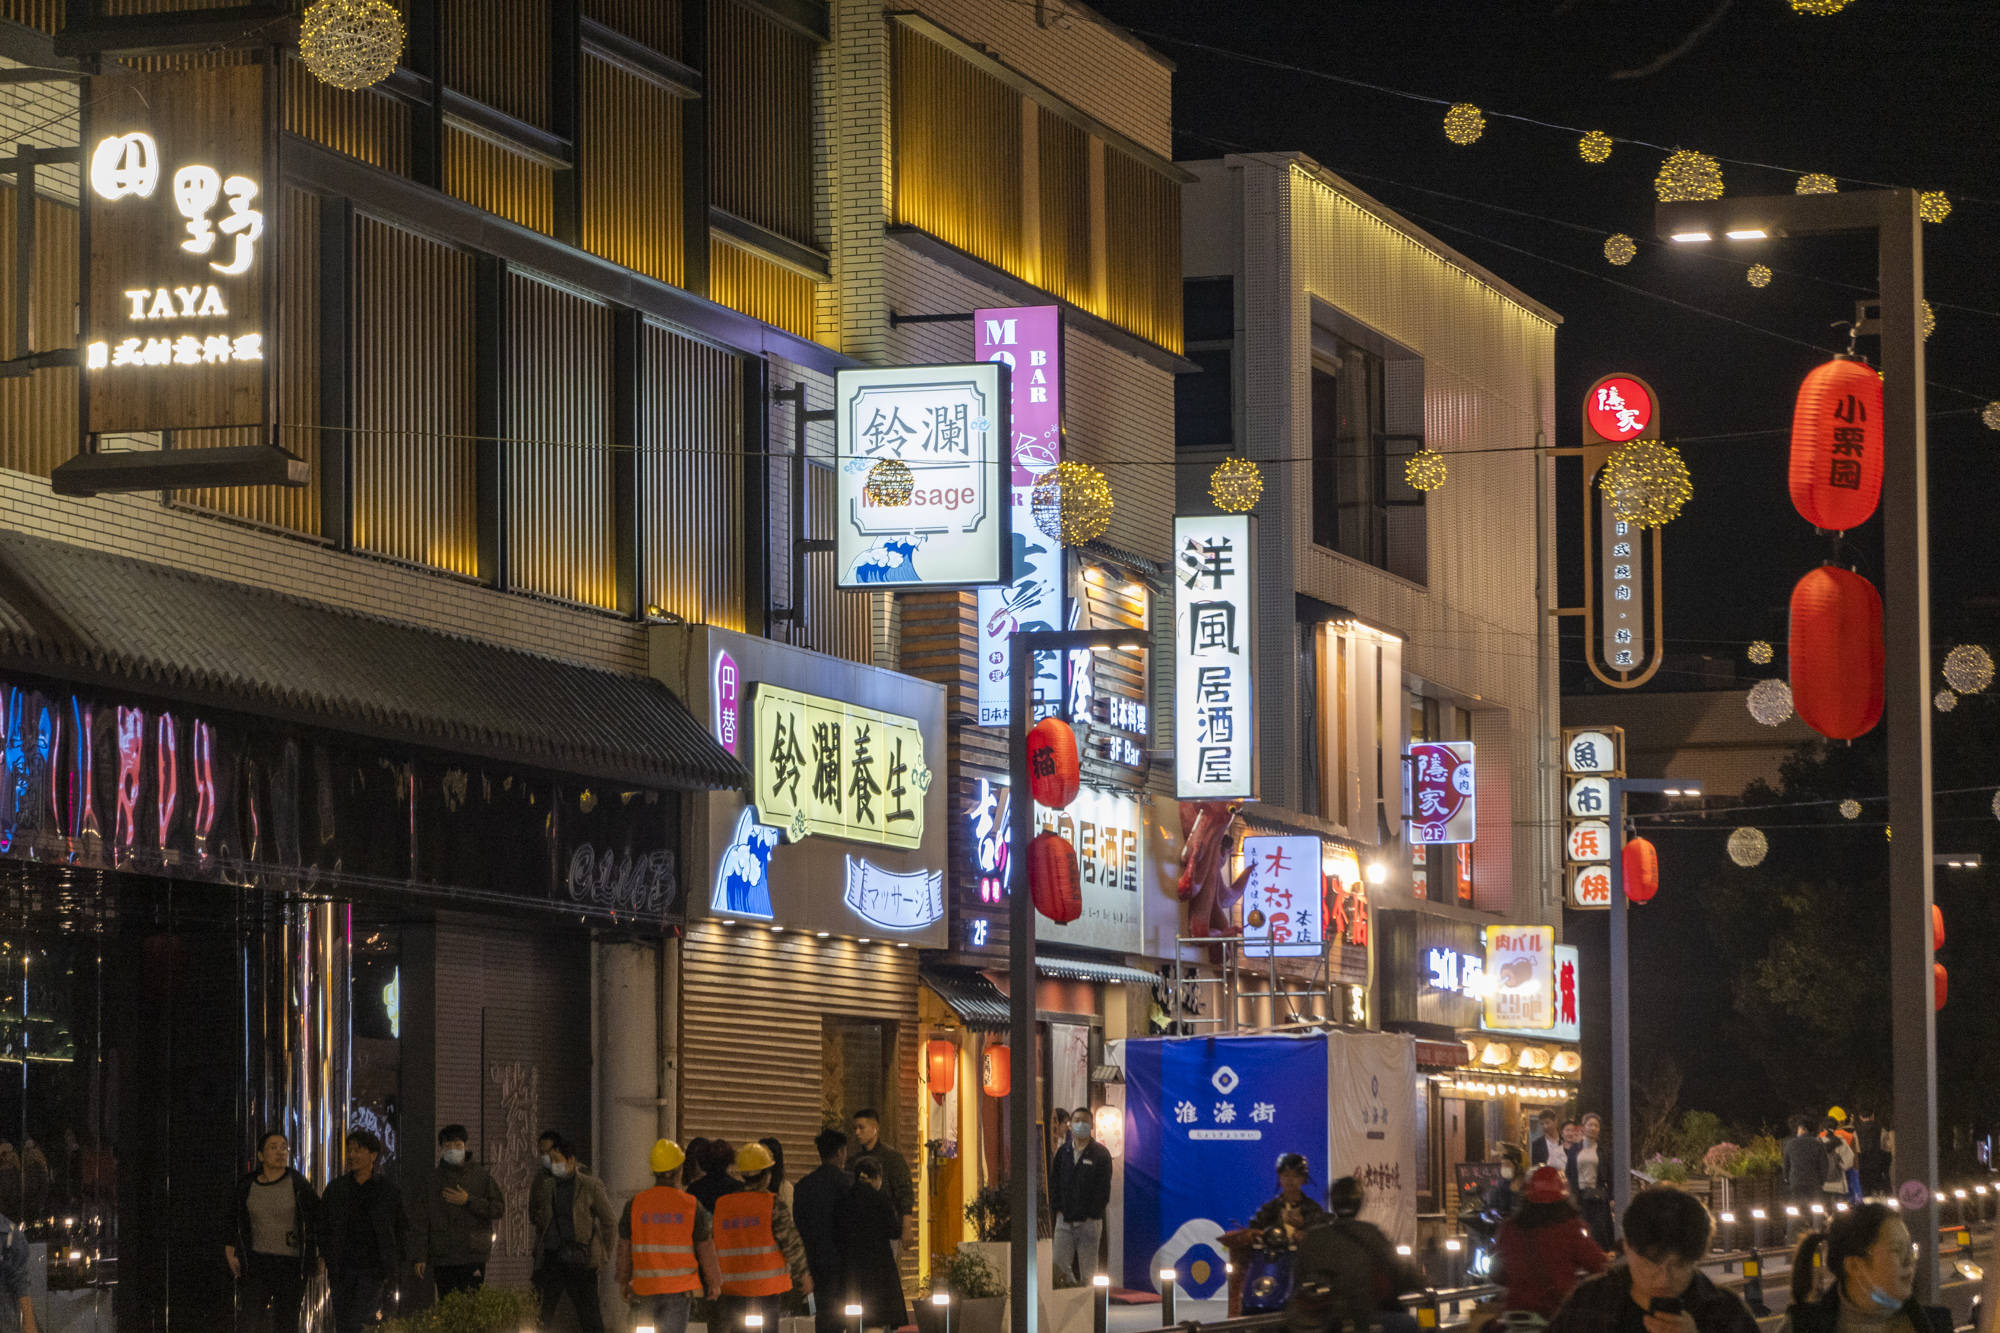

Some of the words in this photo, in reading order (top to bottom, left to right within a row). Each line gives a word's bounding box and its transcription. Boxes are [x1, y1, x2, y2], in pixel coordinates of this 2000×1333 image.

[91, 133, 264, 274] 田野
[125, 285, 228, 320] TAYA
[1030, 350, 1048, 403] BAR
[862, 484, 975, 511] Msage
[1184, 536, 1240, 784] 洋風居酒屋
[722, 665, 736, 744] 円替
[1109, 697, 1146, 735] 日本料理
[1109, 736, 1122, 761] 3F
[1124, 740, 1141, 767] Bar
[1425, 828, 1442, 841] 2F
[867, 883, 926, 918] マッサージ
[1264, 846, 1293, 944] 木村屋
[974, 919, 987, 946] 2F
[1495, 933, 1543, 953] 肉バル
[1174, 1100, 1276, 1124] 淮海街
